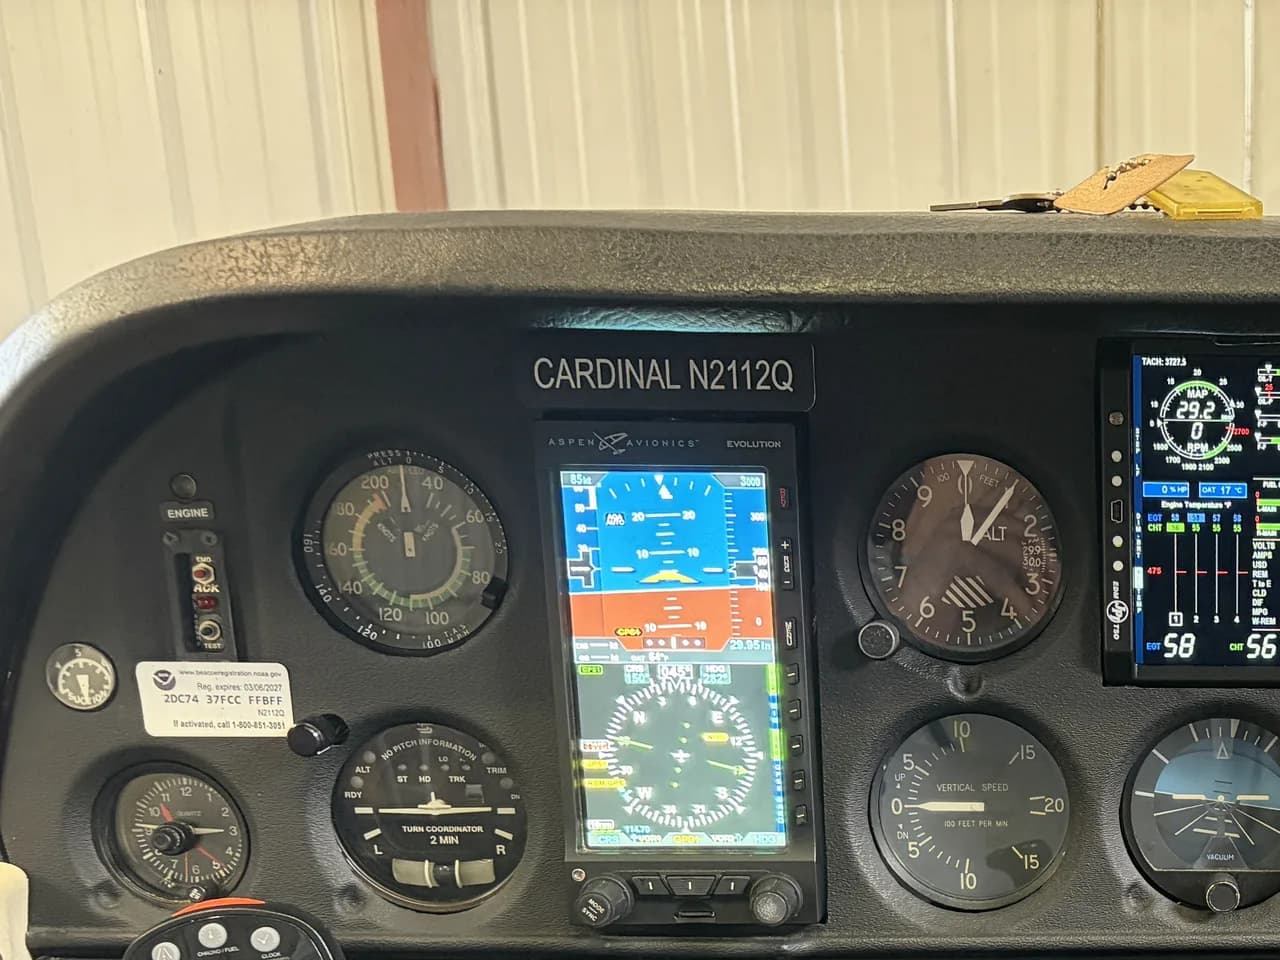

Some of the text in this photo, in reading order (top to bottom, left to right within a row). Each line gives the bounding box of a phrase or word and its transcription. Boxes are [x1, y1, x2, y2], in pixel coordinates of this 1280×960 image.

[1142, 357, 1164, 366] TACH:
[534, 357, 794, 392] CARDINAL N2112Q
[1187, 390, 1208, 399] MAP
[1176, 401, 1215, 419] 29.2
[548, 438, 695, 448] ASPEN AVIONICS
[727, 440, 781, 448] EVOLUTION
[1187, 443, 1209, 452] RPM
[361, 475, 389, 489] 200
[422, 476, 443, 489] 40
[917, 485, 933, 507] 9
[1202, 486, 1231, 495] OAT 17
[168, 508, 209, 518] ENGINE
[892, 519, 906, 541] 8
[472, 572, 490, 584] 80
[379, 608, 402, 621] 120
[425, 612, 448, 624] 100
[962, 611, 976, 632] 5
[1163, 633, 1196, 658] 58
[1247, 634, 1278, 659] 56
[216, 683, 241, 692] expires:
[164, 694, 282, 705] 2DC74 37FCC FFBFF
[258, 709, 285, 717] N2112Q
[954, 721, 970, 737] 10
[381, 738, 478, 762] NO PITCH INFORMATION
[1020, 744, 1036, 760] 15
[355, 766, 371, 774] ALT
[937, 784, 1009, 792] VERTICAL SPEED
[344, 791, 362, 799] RDY
[1044, 798, 1064, 813] 20
[426, 825, 484, 833] COORDINATOR
[430, 836, 459, 845] 2 MIN
[1206, 853, 1235, 861] VACUUM
